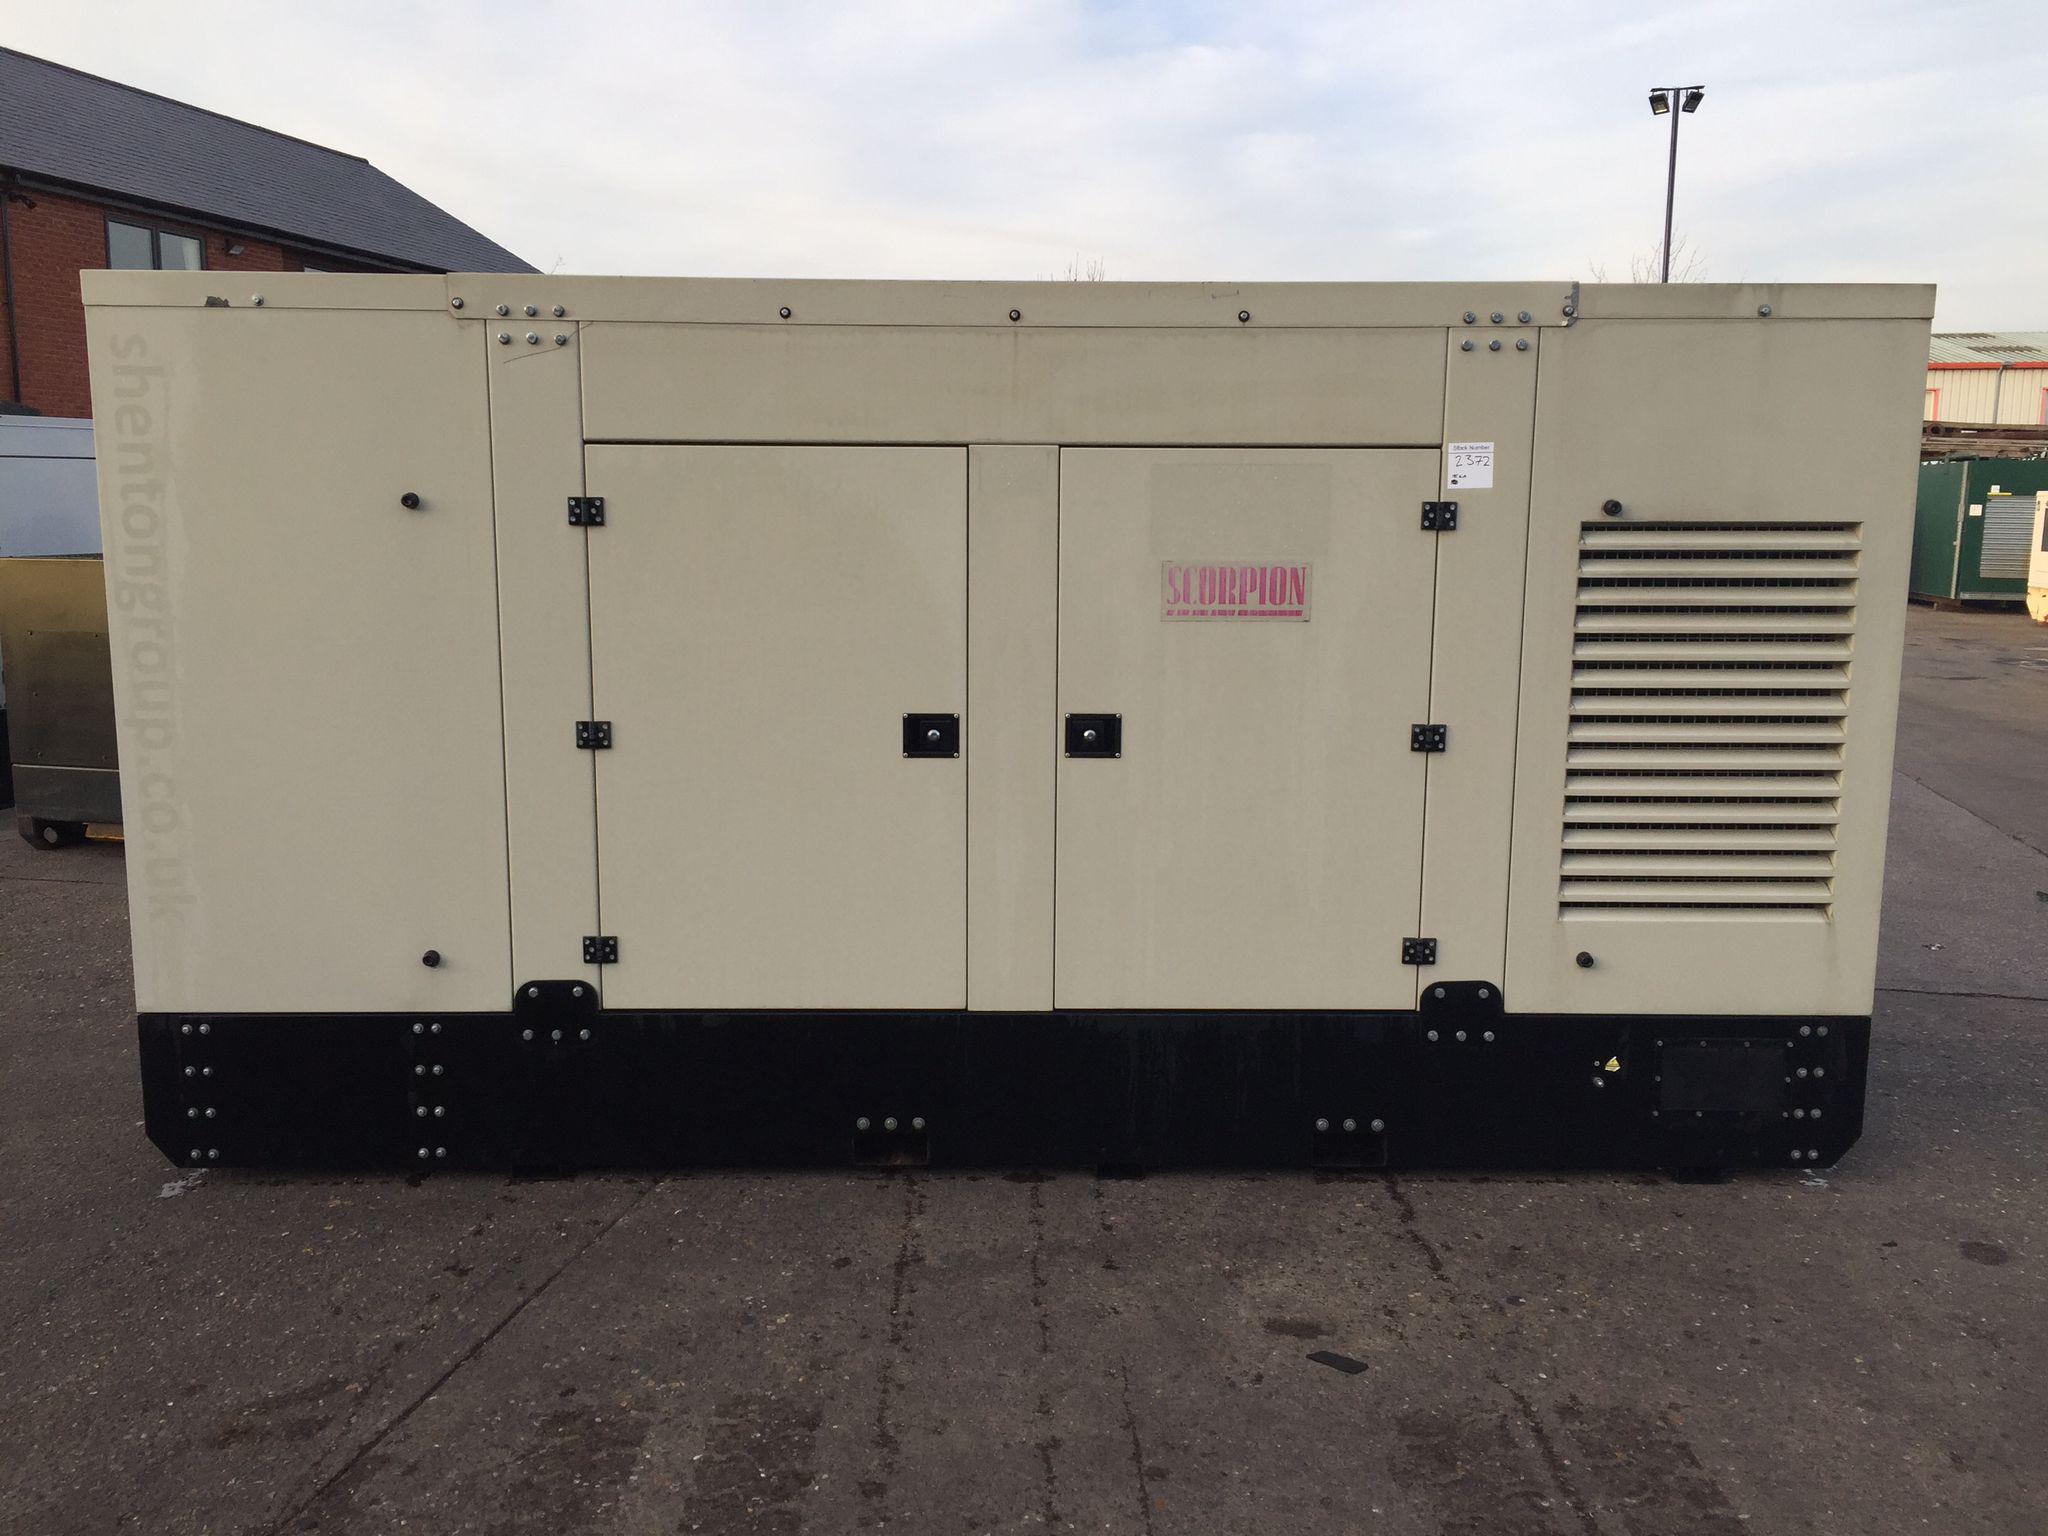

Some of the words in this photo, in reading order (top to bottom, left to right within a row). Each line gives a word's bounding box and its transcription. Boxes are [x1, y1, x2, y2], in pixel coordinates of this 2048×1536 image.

[1455, 455, 1490, 467] 2372
[1167, 566, 1307, 605] SCORPION
[112, 334, 197, 923] shentongroup.co.uk
